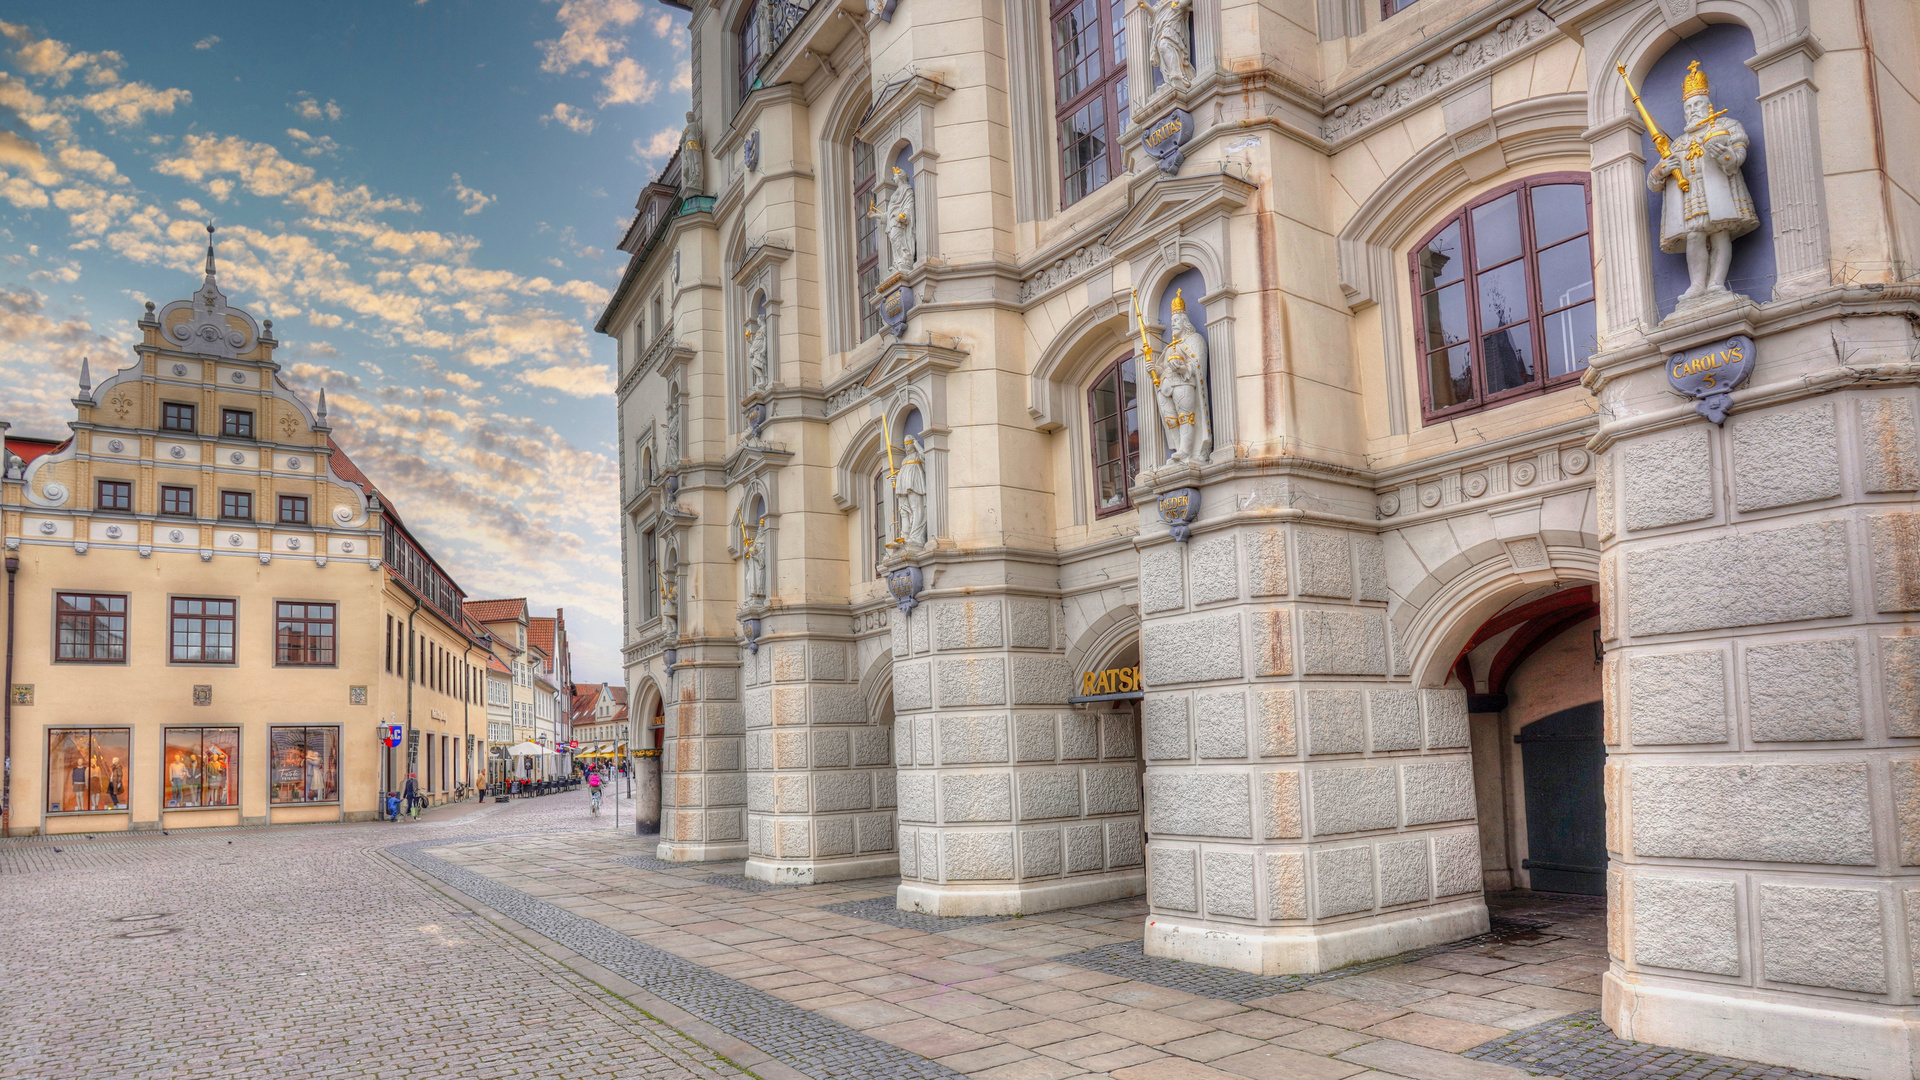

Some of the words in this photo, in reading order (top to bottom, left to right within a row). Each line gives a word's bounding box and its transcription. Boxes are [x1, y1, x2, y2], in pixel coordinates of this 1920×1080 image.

[1145, 117, 1183, 149] VERITAS
[1672, 347, 1744, 379] CAROLVS
[1702, 373, 1716, 389] 5
